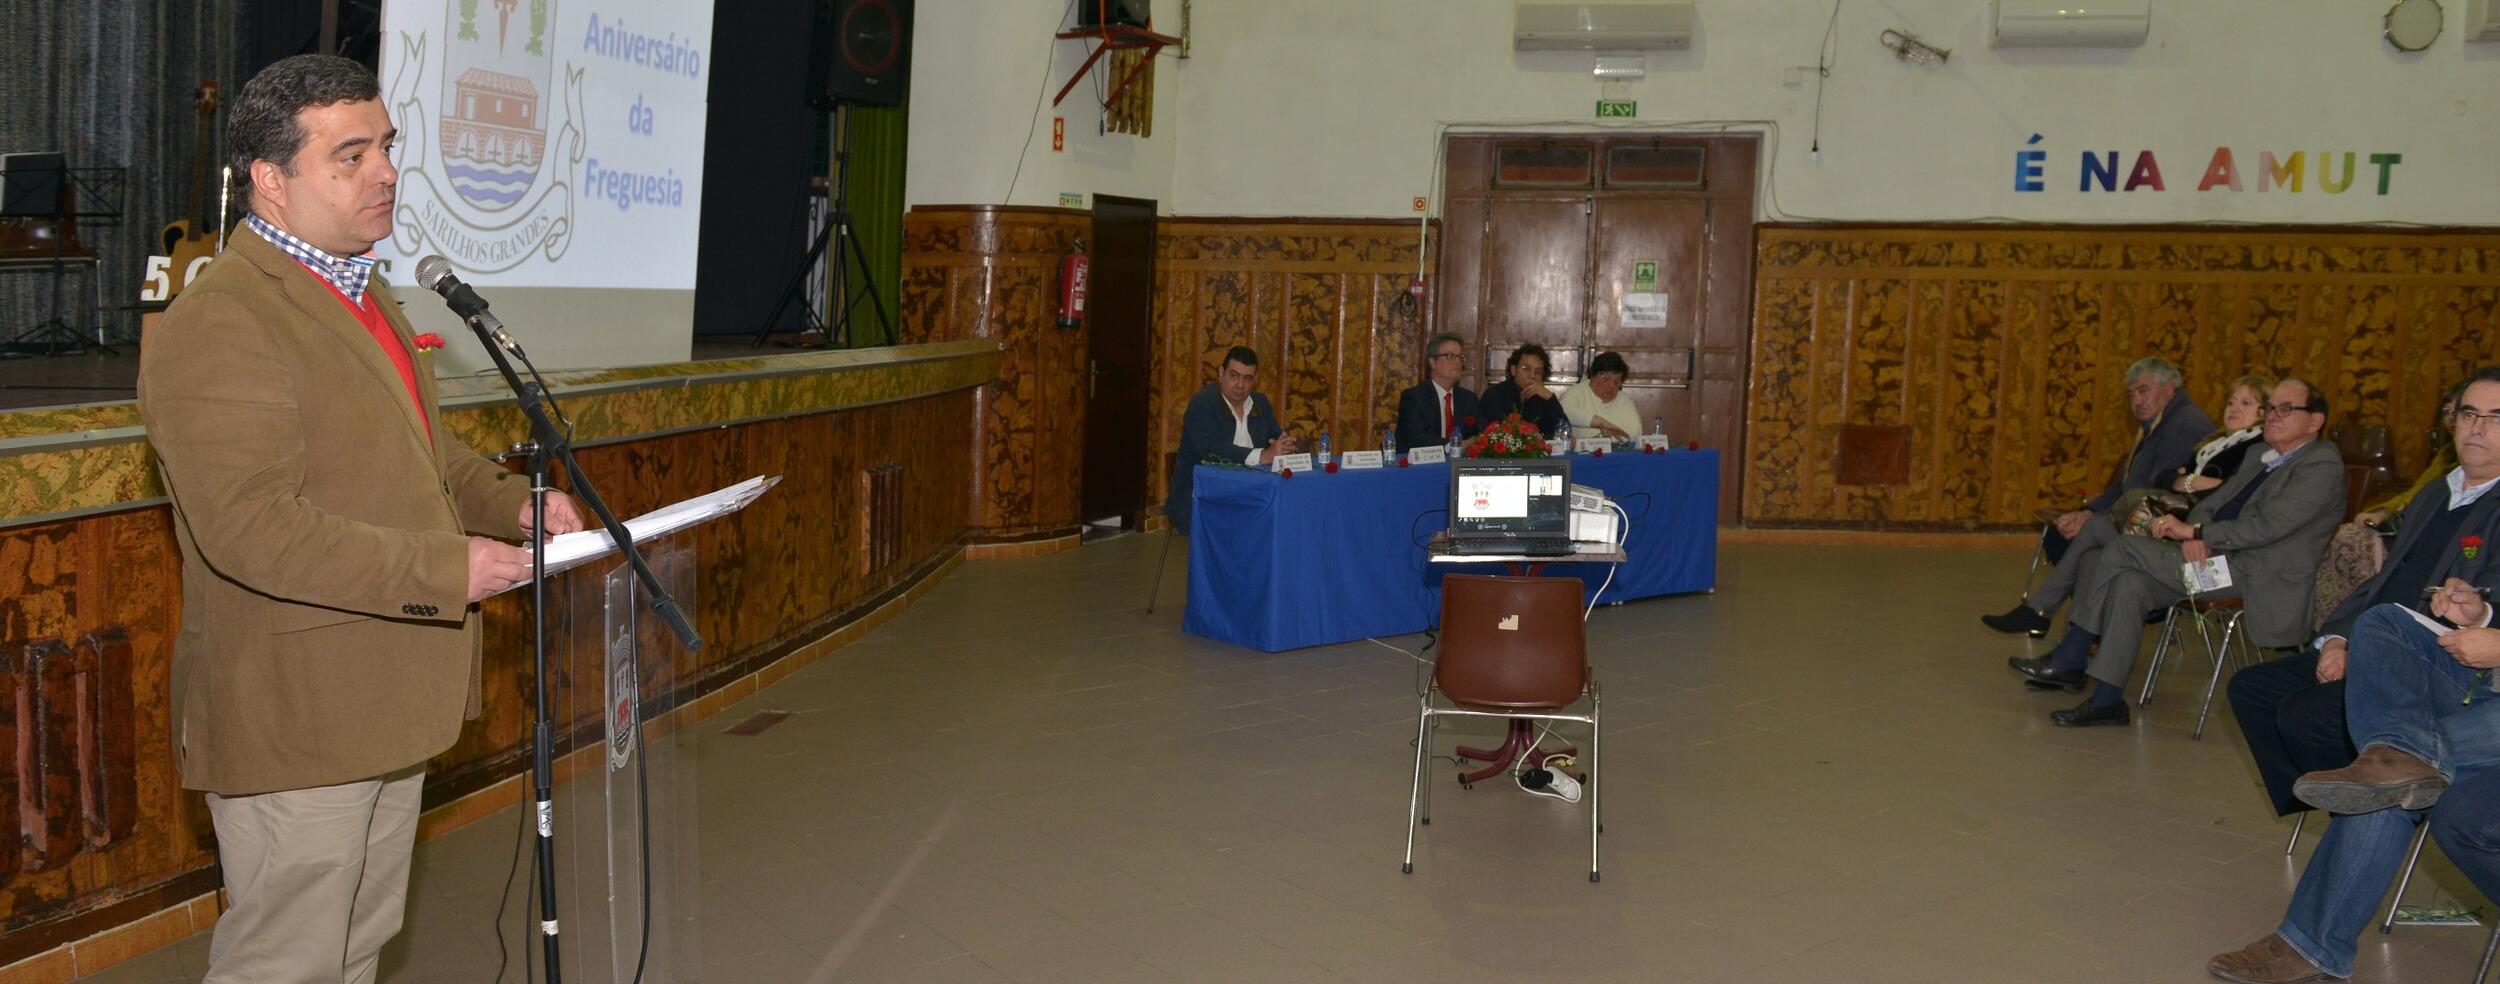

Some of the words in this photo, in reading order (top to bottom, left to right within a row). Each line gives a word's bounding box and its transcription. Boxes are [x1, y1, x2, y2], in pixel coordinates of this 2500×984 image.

[584, 12, 700, 79] Aniversário
[629, 93, 654, 137] da
[584, 158, 683, 211] Freguesia
[2014, 133, 2046, 192] É
[2080, 150, 2166, 192] NA
[2197, 147, 2402, 195] AMUT
[422, 199, 488, 264] SARILHOS
[490, 208, 550, 264] GRANDES
